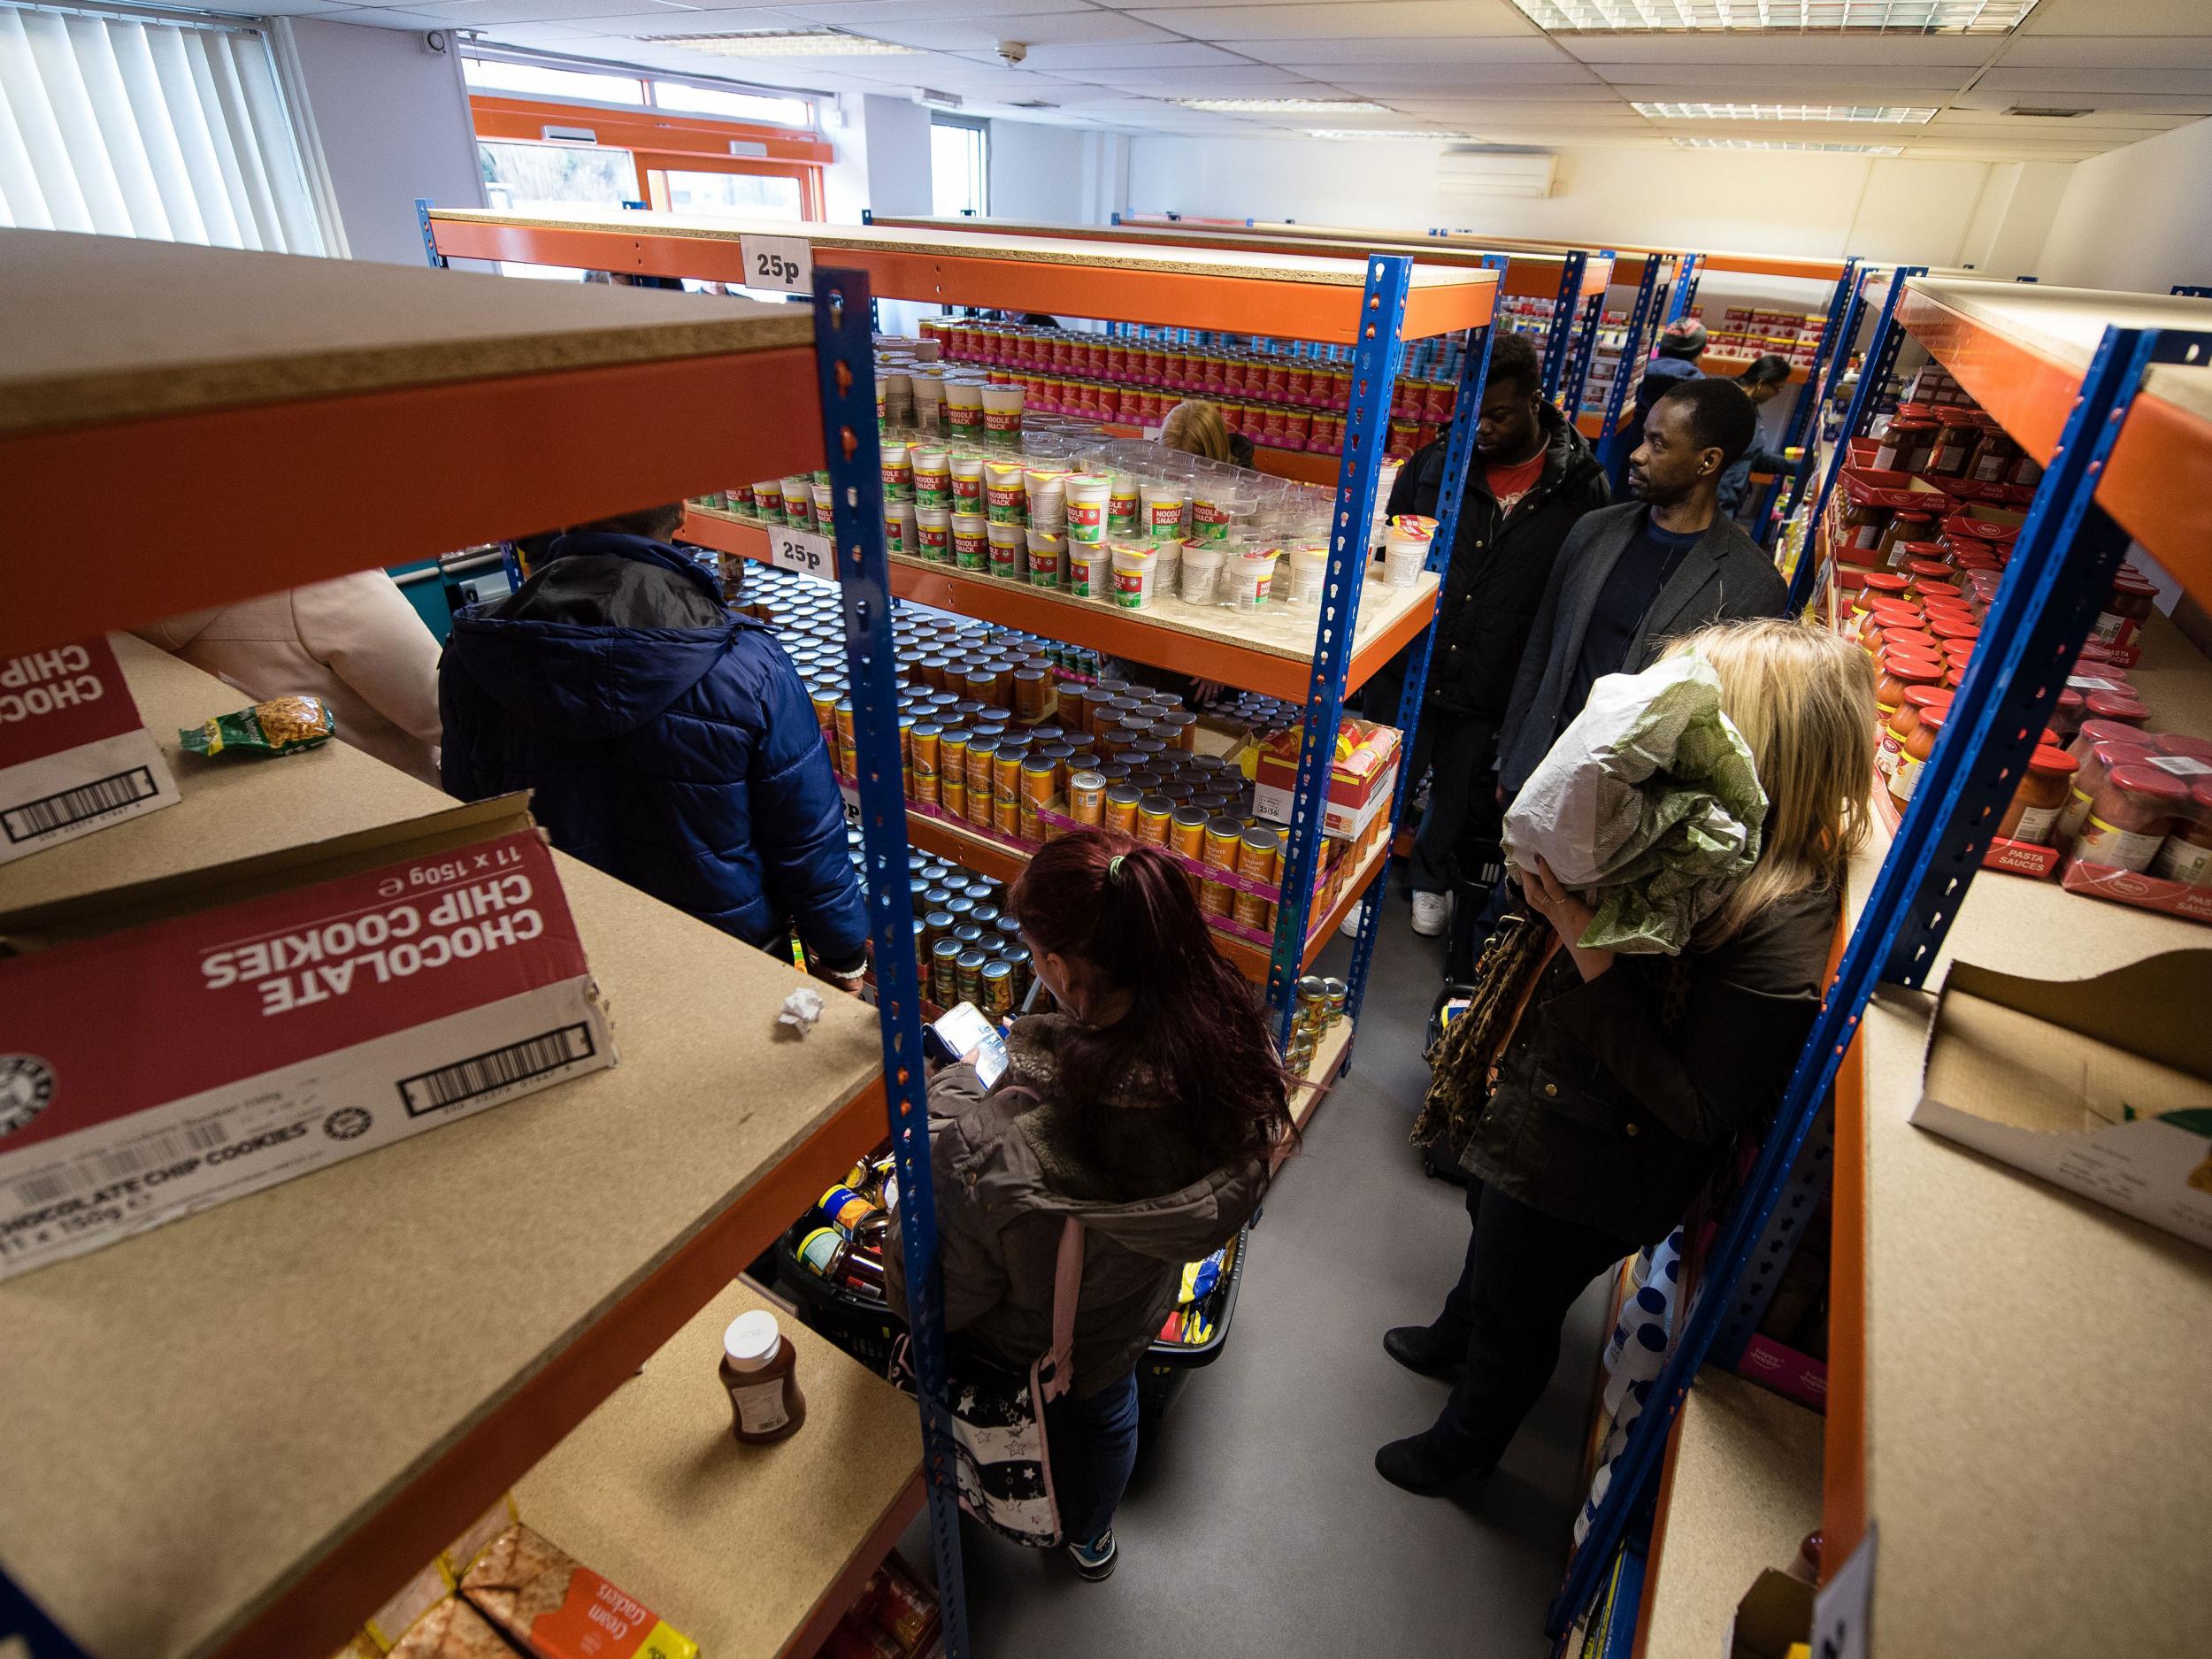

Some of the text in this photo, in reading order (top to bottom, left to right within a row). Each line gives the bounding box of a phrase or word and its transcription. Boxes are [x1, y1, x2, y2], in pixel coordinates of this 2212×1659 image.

[757, 254, 799, 284] 25p
[1156, 509, 1181, 518] NOODLE
[1156, 516, 1179, 525] SNACK
[955, 538, 979, 547] NOODLE
[783, 541, 820, 570] 25p
[1, 645, 90, 688] CHIP
[0, 675, 104, 724] CHOC
[1258, 805, 1279, 816] 25156
[472, 855, 490, 869] x
[496, 846, 522, 866] 11
[1242, 856, 1265, 866] Spaghetti
[1244, 863, 1261, 872] Hoops
[1998, 856, 2046, 872] SAUCES
[2008, 849, 2045, 863] PASTA
[410, 860, 469, 886] 150g
[201, 874, 534, 989] CHIP COOKIES
[258, 908, 545, 1017] CHOCOLATE
[0, 1179, 142, 1235] HOCOLATE
[205, 1121, 308, 1166] COOKIES
[595, 1583, 647, 1626] Crackers
[588, 1603, 628, 1641] Cream
